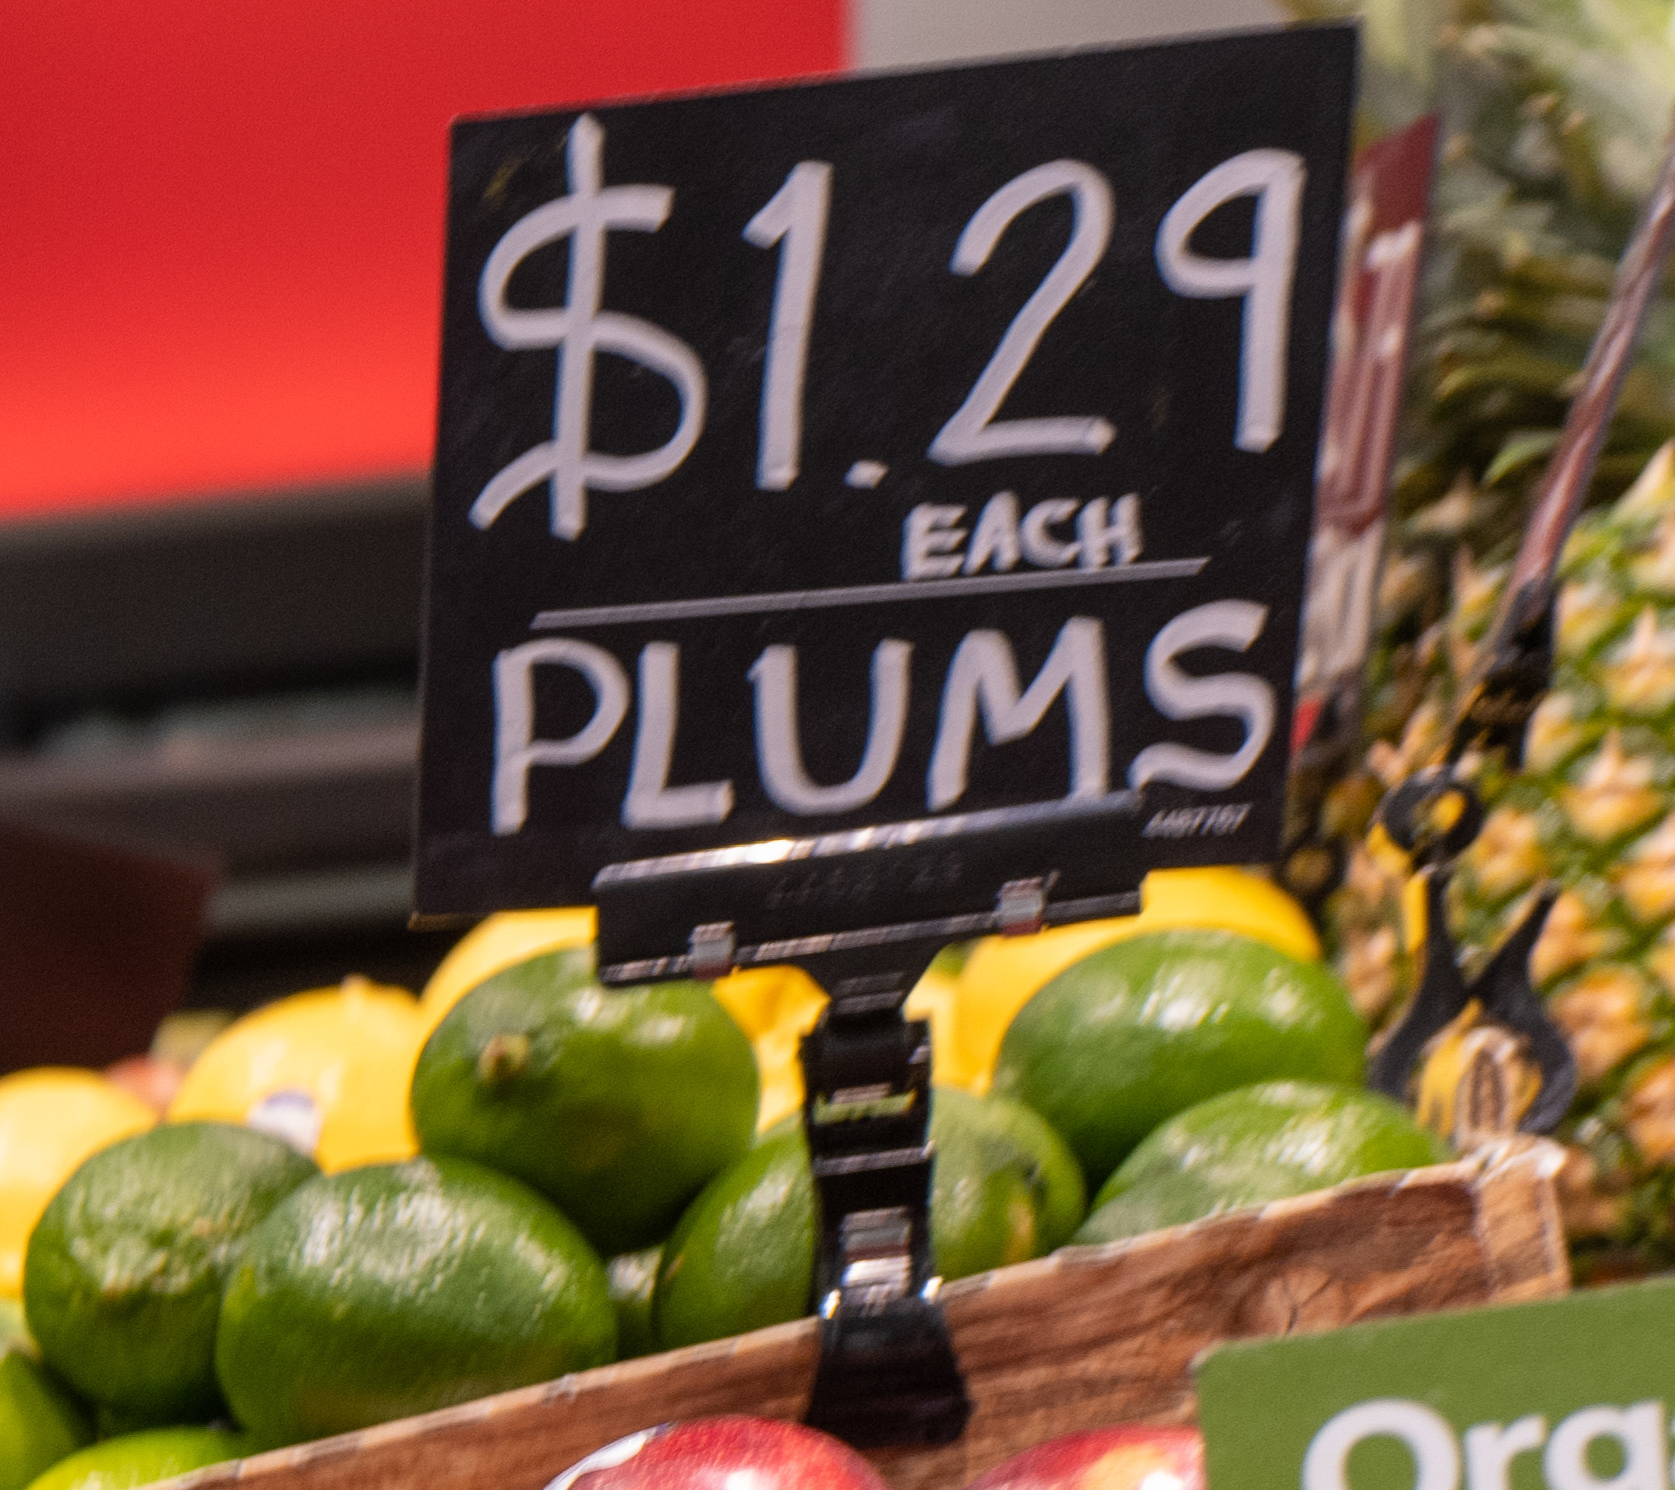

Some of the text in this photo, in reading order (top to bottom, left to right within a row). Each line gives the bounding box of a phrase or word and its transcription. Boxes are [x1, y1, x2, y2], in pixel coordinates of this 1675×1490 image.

[471, 112, 1306, 538] $1.29
[901, 491, 1141, 582] EACH
[489, 600, 1277, 837] PLUMS
